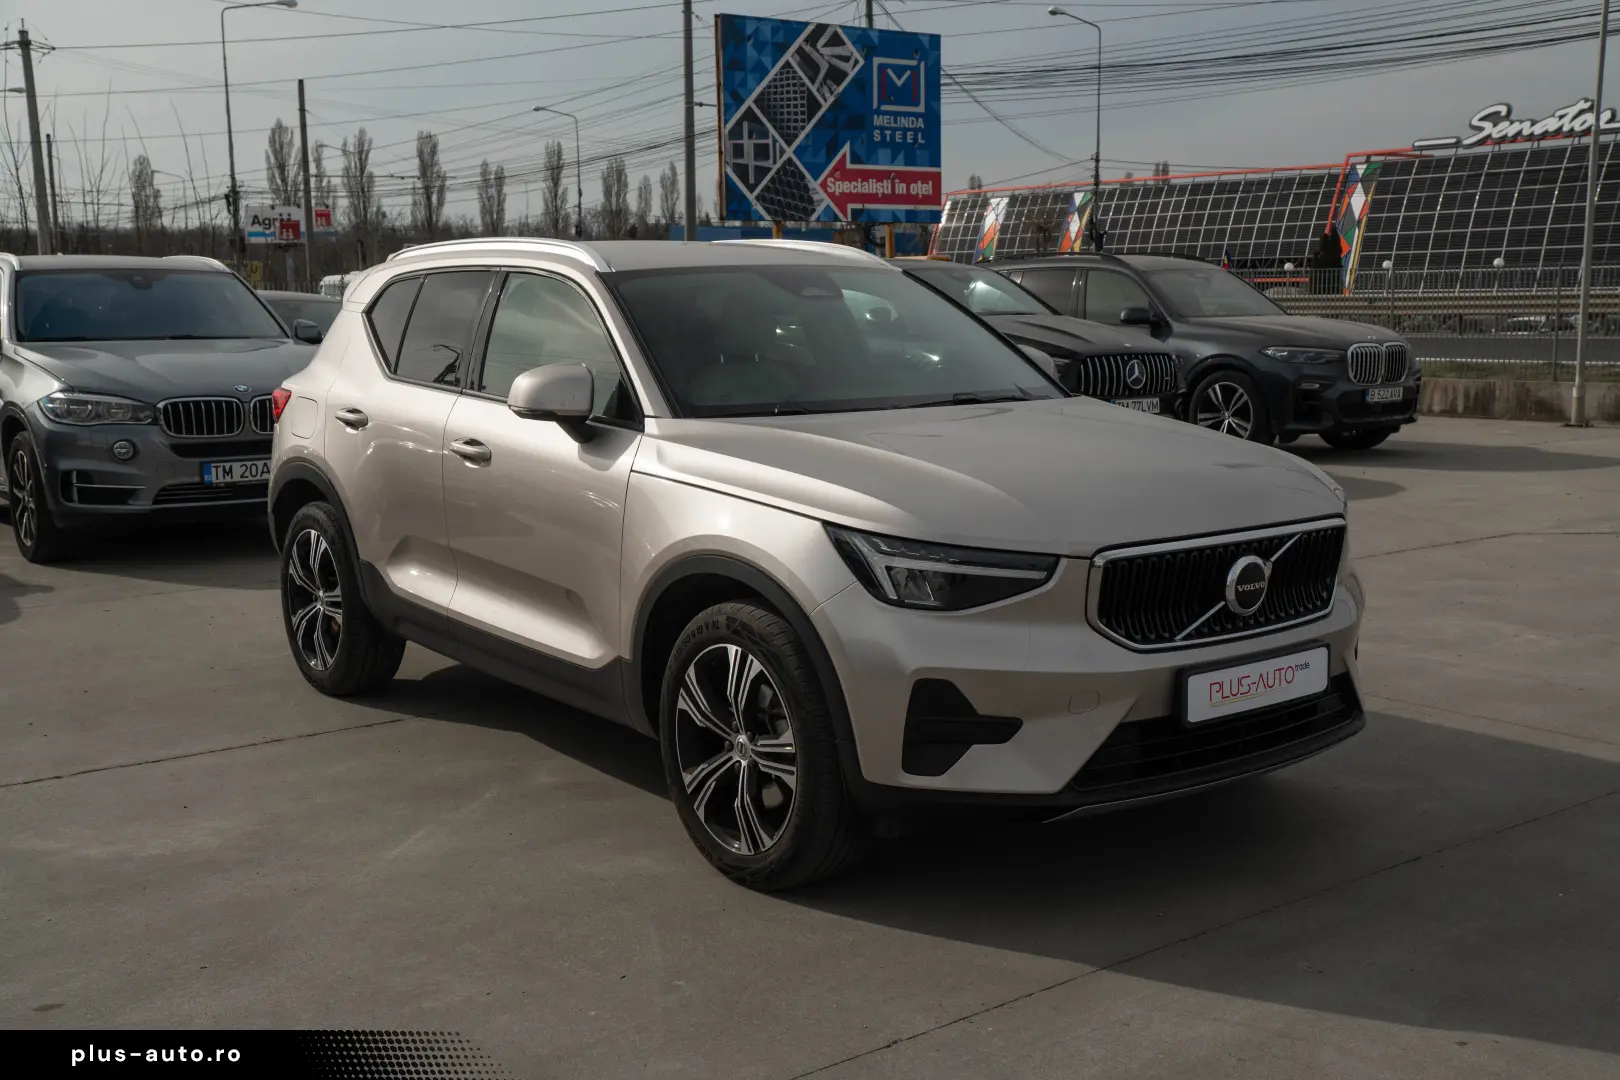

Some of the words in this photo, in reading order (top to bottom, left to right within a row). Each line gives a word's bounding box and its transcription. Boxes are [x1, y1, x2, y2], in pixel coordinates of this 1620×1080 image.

[873, 115, 925, 128] MELINDA
[873, 130, 926, 144] STEEL
[212, 465, 233, 480] TM
[1237, 581, 1266, 592] VOLVO
[1209, 665, 1295, 702] PLUS-AUTO
[1295, 660, 1310, 672] trade
